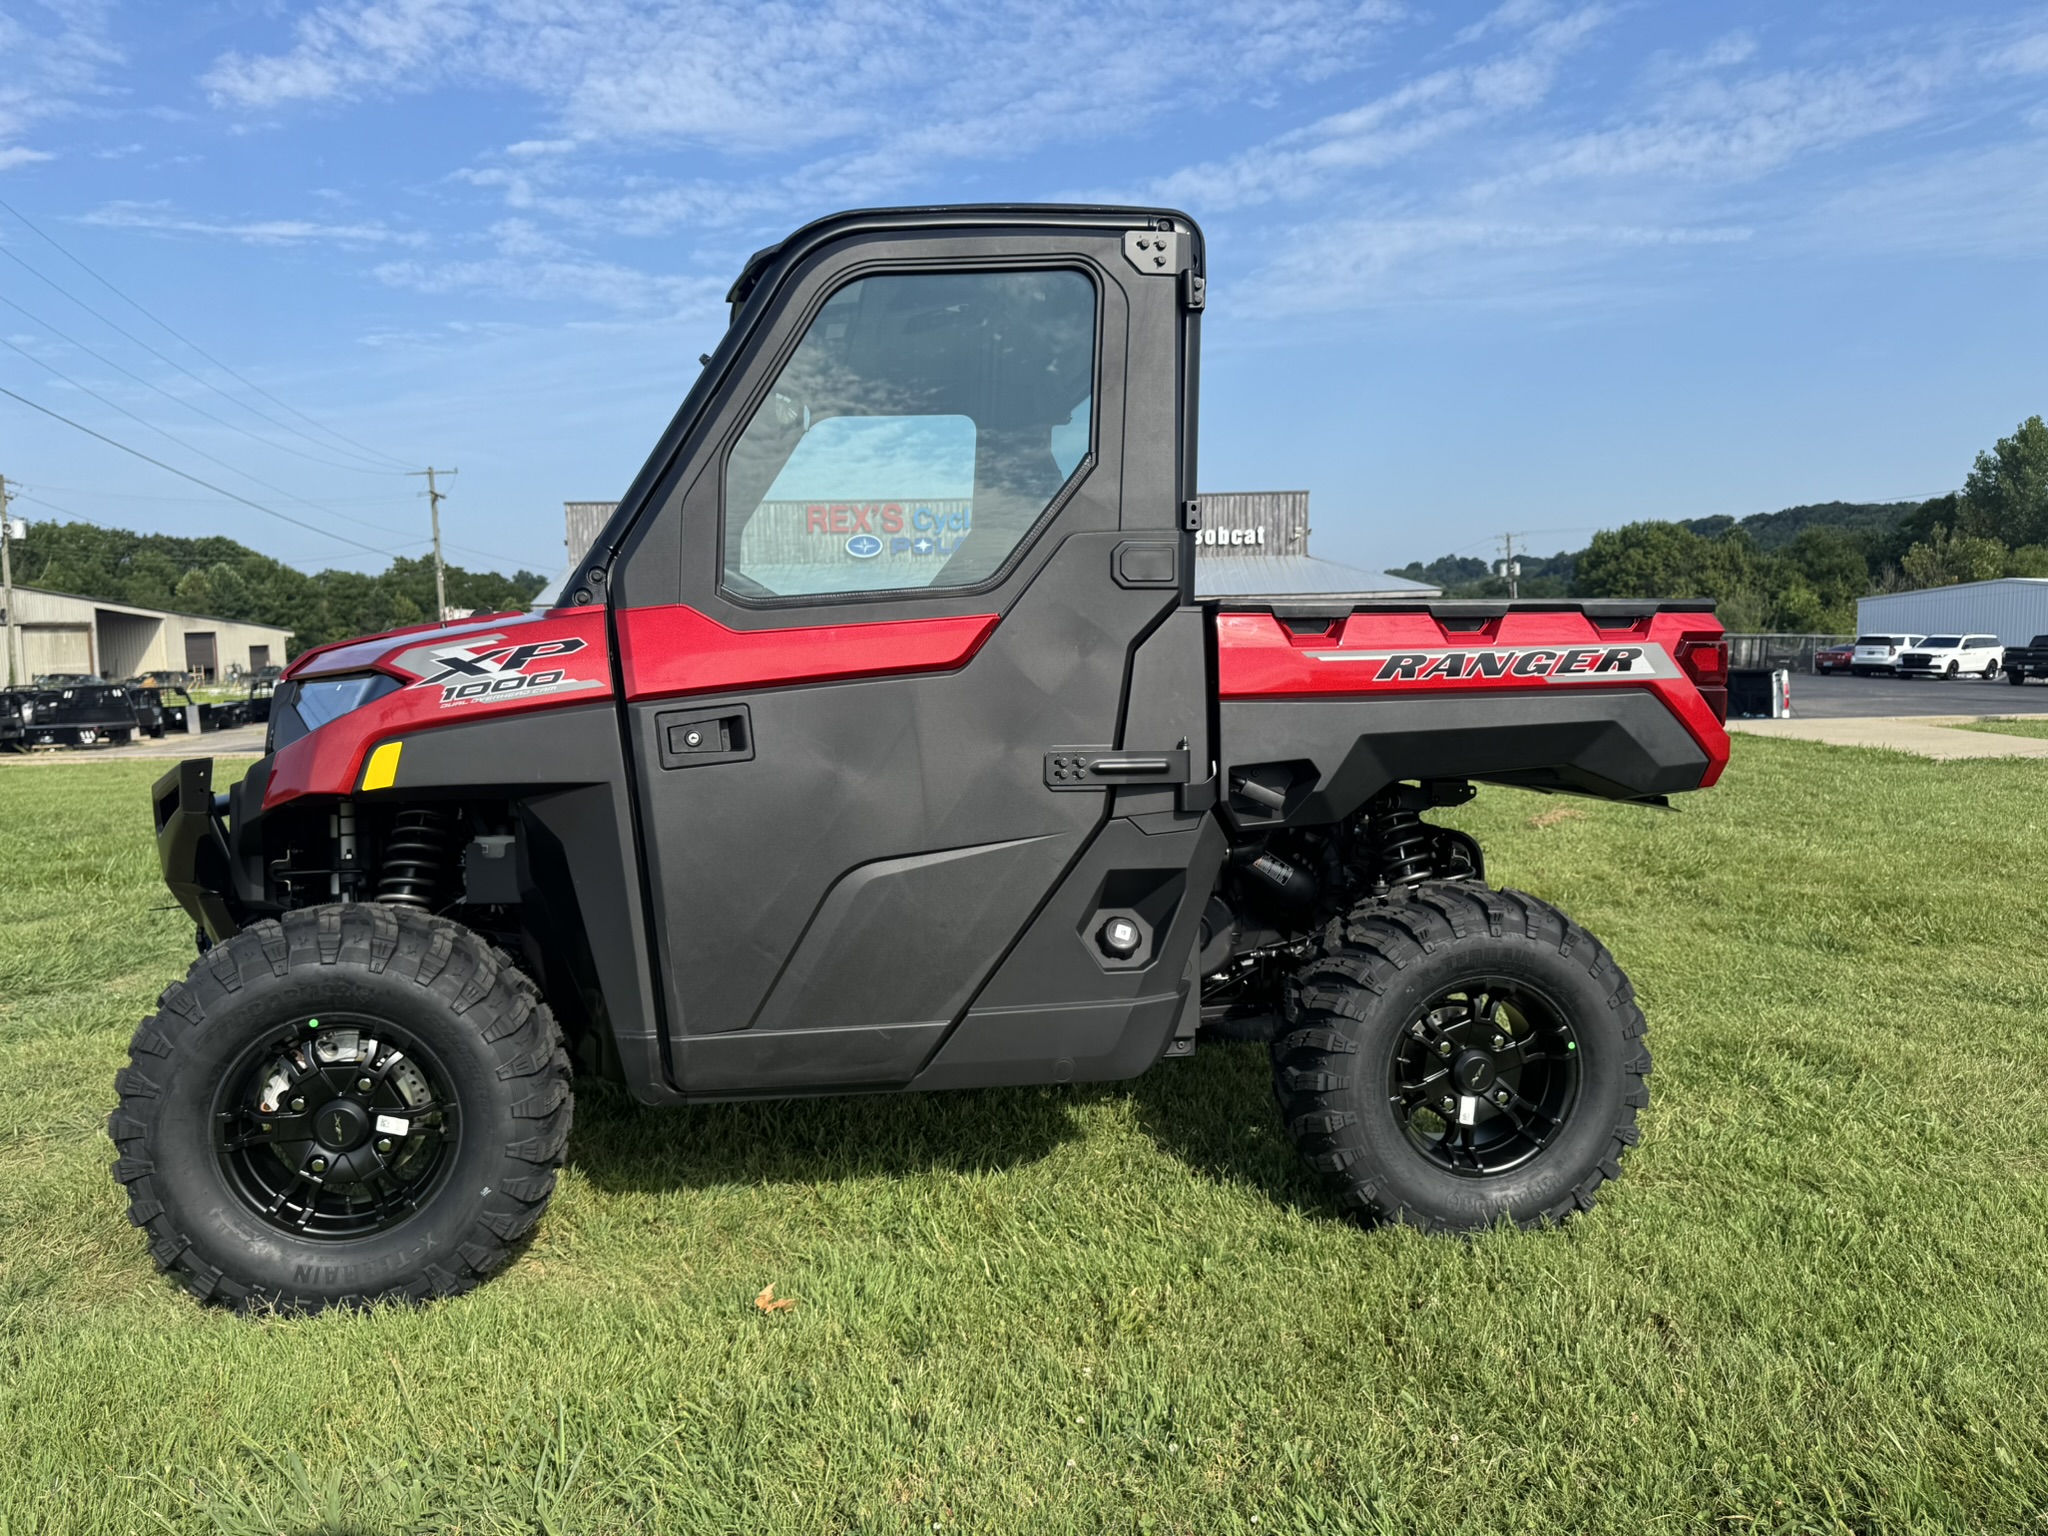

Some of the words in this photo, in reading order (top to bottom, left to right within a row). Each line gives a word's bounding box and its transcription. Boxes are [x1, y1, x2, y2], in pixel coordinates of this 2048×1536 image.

[807, 505, 904, 533] REX'S
[404, 637, 588, 690] XP
[1373, 647, 1645, 681] RANGER
[439, 669, 565, 704] 1000
[440, 700, 468, 709] DUAL
[470, 690, 530, 704] OVERHEAD
[532, 686, 557, 695] CAM
